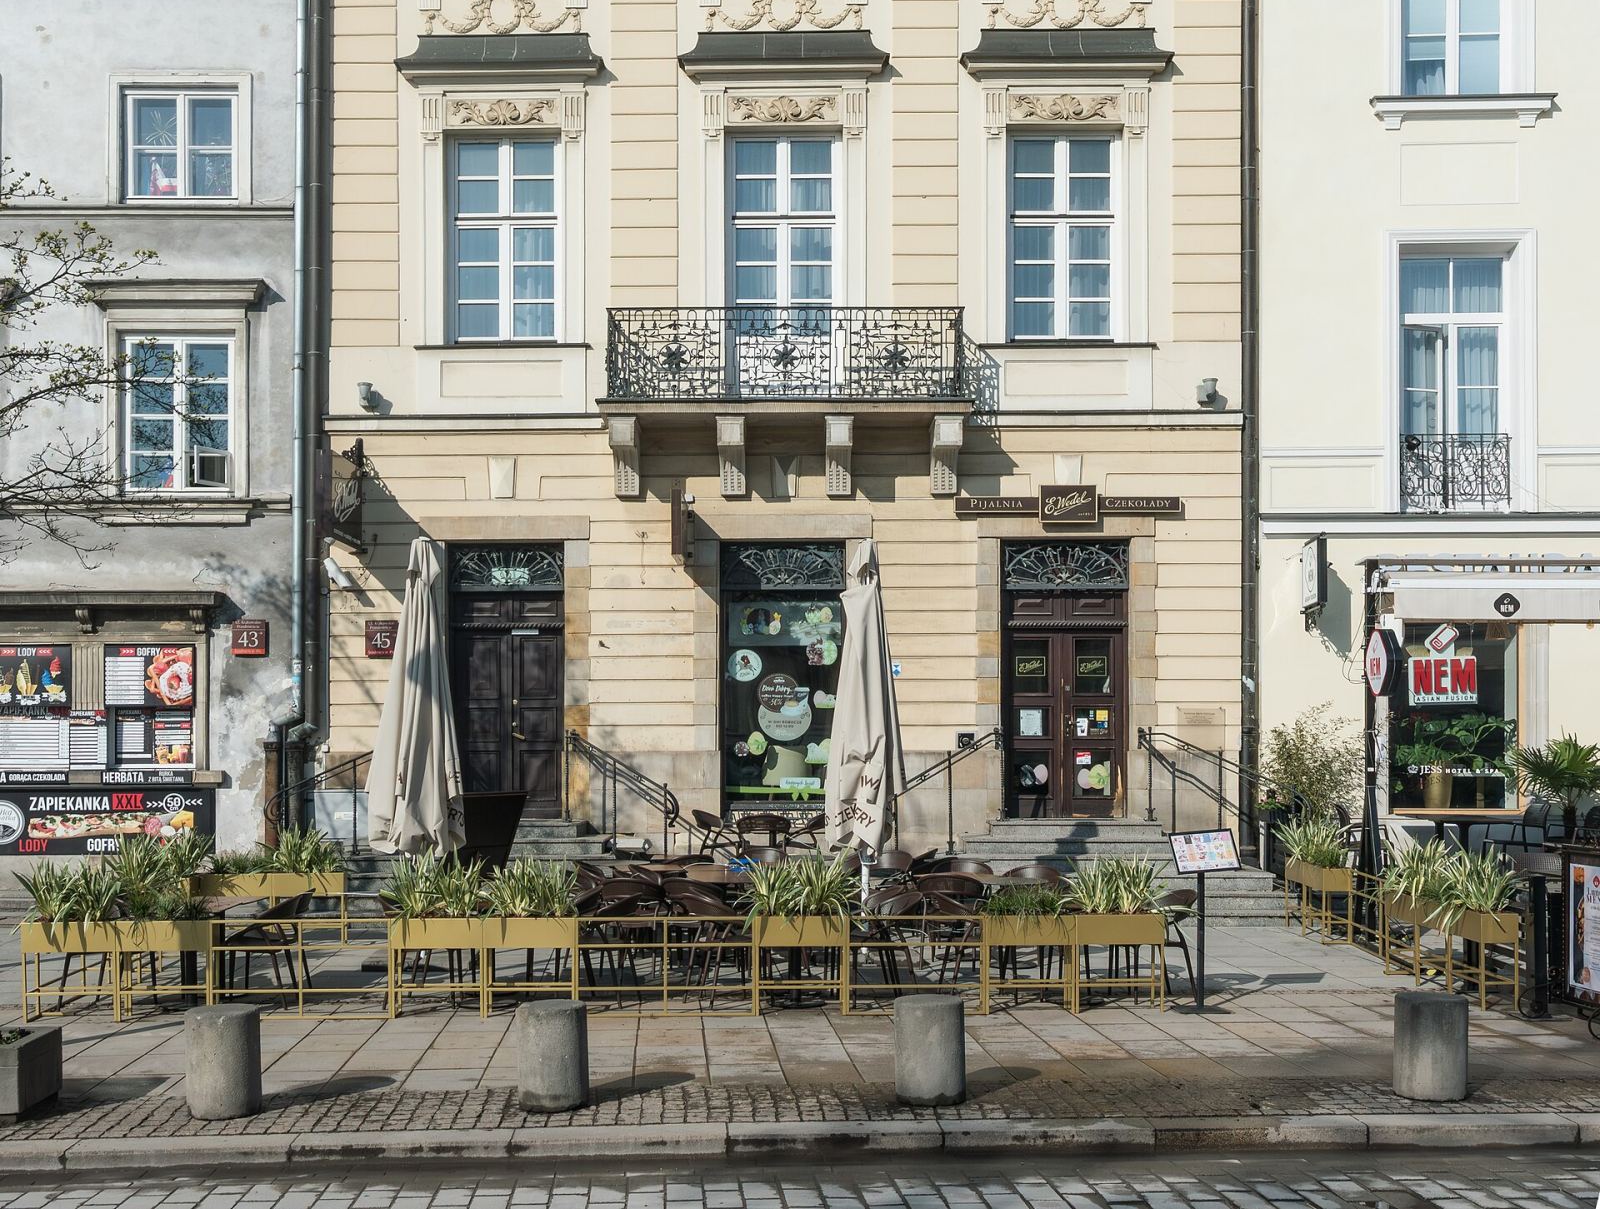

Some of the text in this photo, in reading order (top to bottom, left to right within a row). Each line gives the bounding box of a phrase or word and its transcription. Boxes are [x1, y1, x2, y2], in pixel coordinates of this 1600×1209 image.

[970, 498, 1023, 510] PIJALNIA
[1106, 498, 1171, 510] CZEKOLADY
[1500, 604, 1514, 613] NEM
[238, 631, 259, 648] 43
[371, 632, 391, 649] 45
[17, 648, 37, 657] LODY
[136, 647, 160, 657] GOFRY
[1413, 659, 1477, 695] NEM
[1420, 765, 1443, 775] JESS
[9, 773, 32, 783] GORĄCA
[33, 773, 66, 782] CZEKOLADA
[103, 772, 144, 783] HERBATA
[29, 794, 181, 811] ZAPIEKANKA XXL 50
[18, 839, 48, 852] LODY
